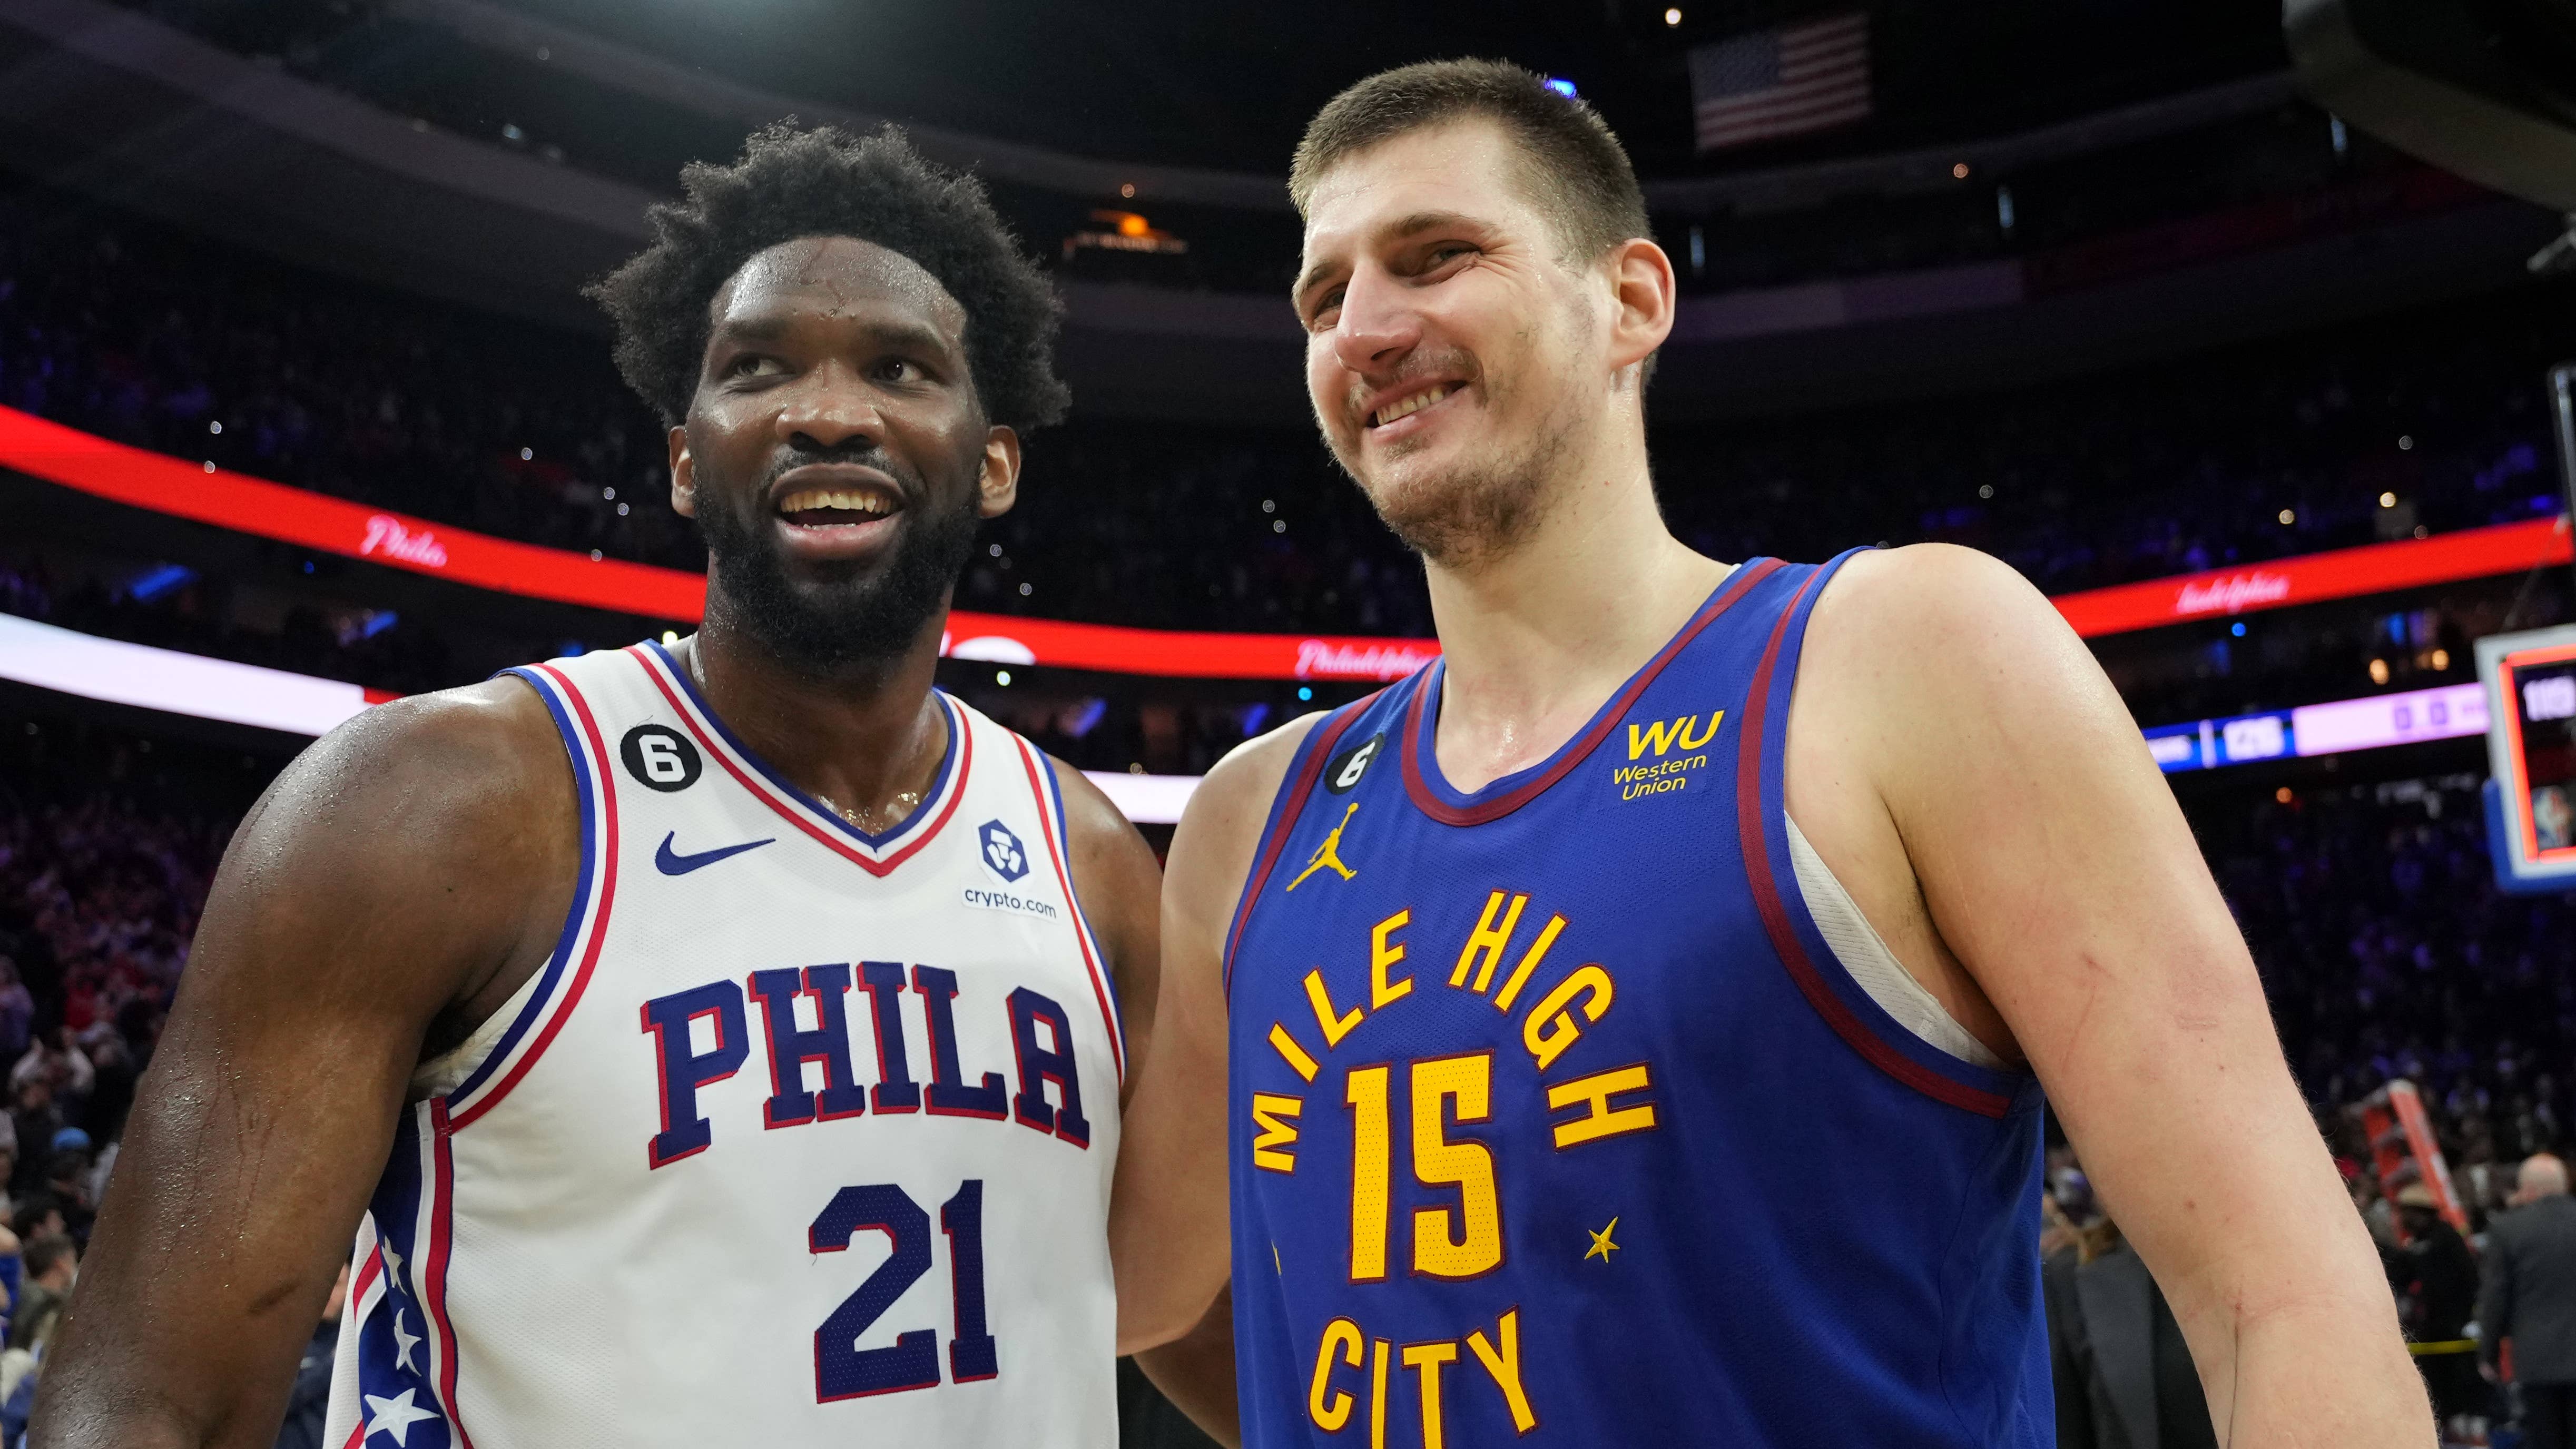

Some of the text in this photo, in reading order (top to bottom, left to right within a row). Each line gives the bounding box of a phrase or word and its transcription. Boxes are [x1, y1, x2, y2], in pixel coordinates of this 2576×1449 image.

[638, 734, 686, 783] 6
[1628, 710, 1725, 761] WU
[1335, 741, 1376, 788] 6
[1614, 755, 1707, 785] Western
[1622, 777, 1686, 801] Union
[965, 889, 1057, 919] crypto.com
[1252, 887, 1659, 1176] MILE HIGH
[640, 961, 1090, 1170] PHILA
[1343, 1049, 1506, 1285] 15
[808, 1179, 998, 1404] 21
[1308, 1304, 1539, 1449] CITY
